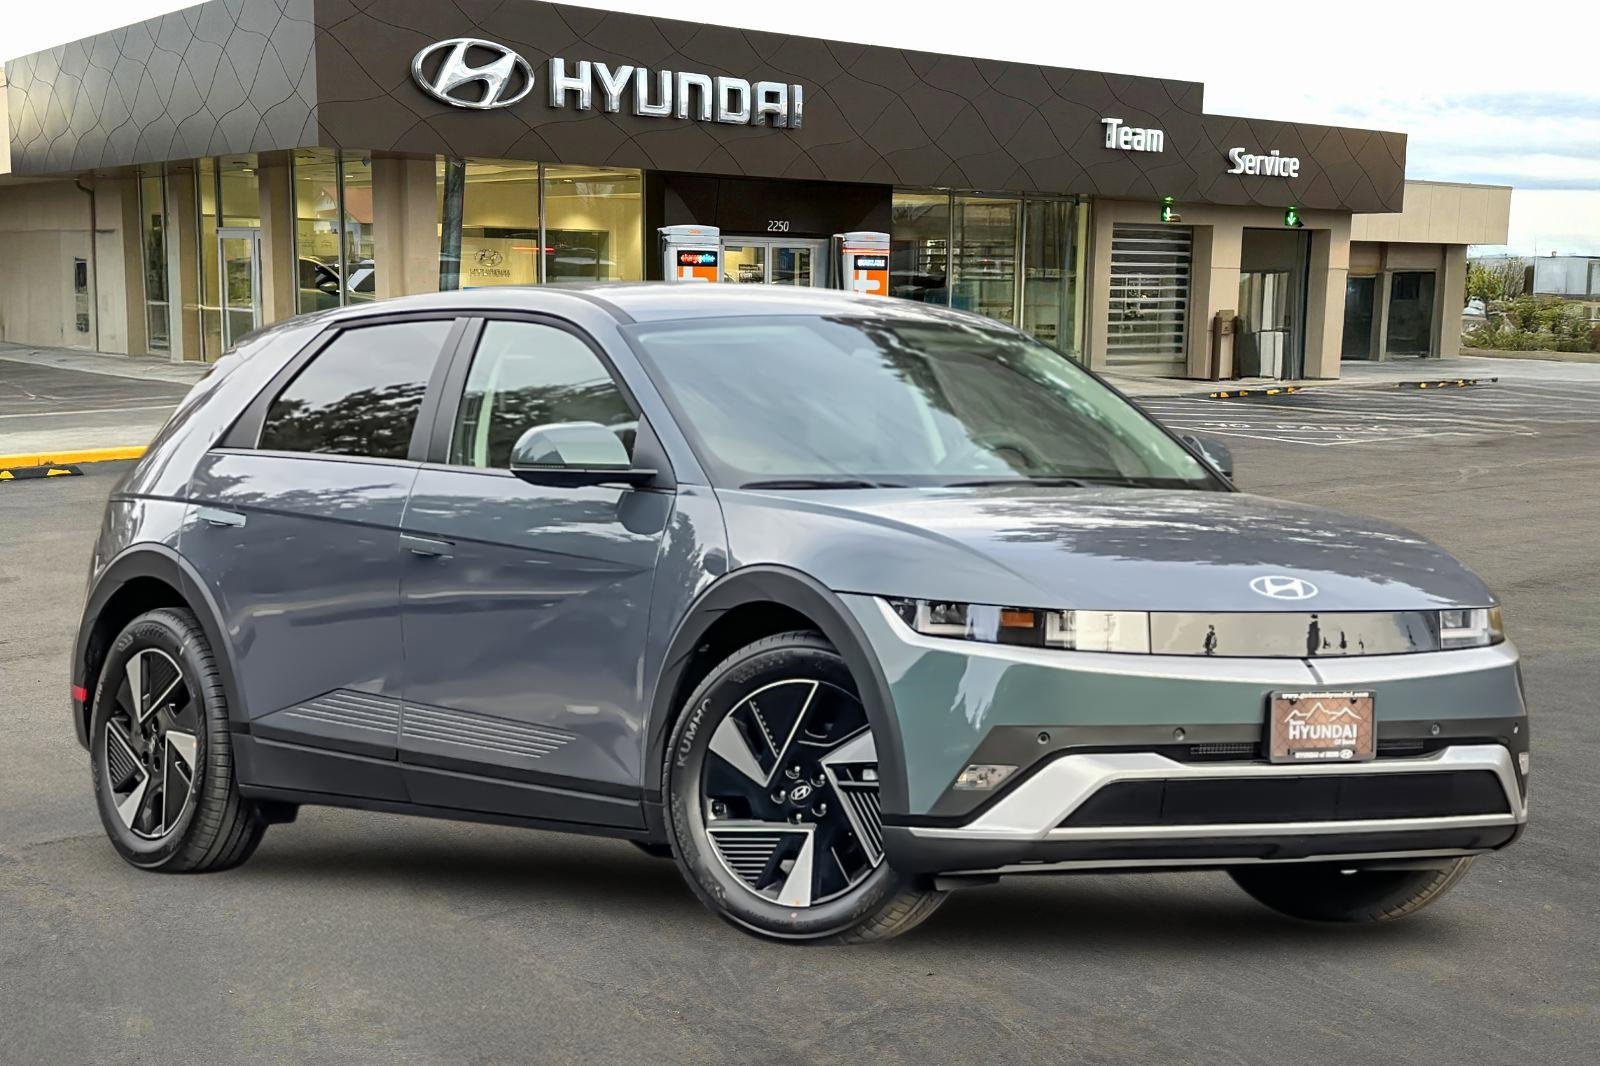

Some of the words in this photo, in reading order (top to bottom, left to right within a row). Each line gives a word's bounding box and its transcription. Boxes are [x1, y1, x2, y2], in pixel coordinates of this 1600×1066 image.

[550, 57, 803, 129] HYUNDAI
[1101, 117, 1165, 153] Team
[1227, 147, 1300, 178] Service
[767, 220, 789, 232] 2250
[677, 697, 711, 767] KUMHO
[1288, 724, 1357, 740] HYUNDAI
